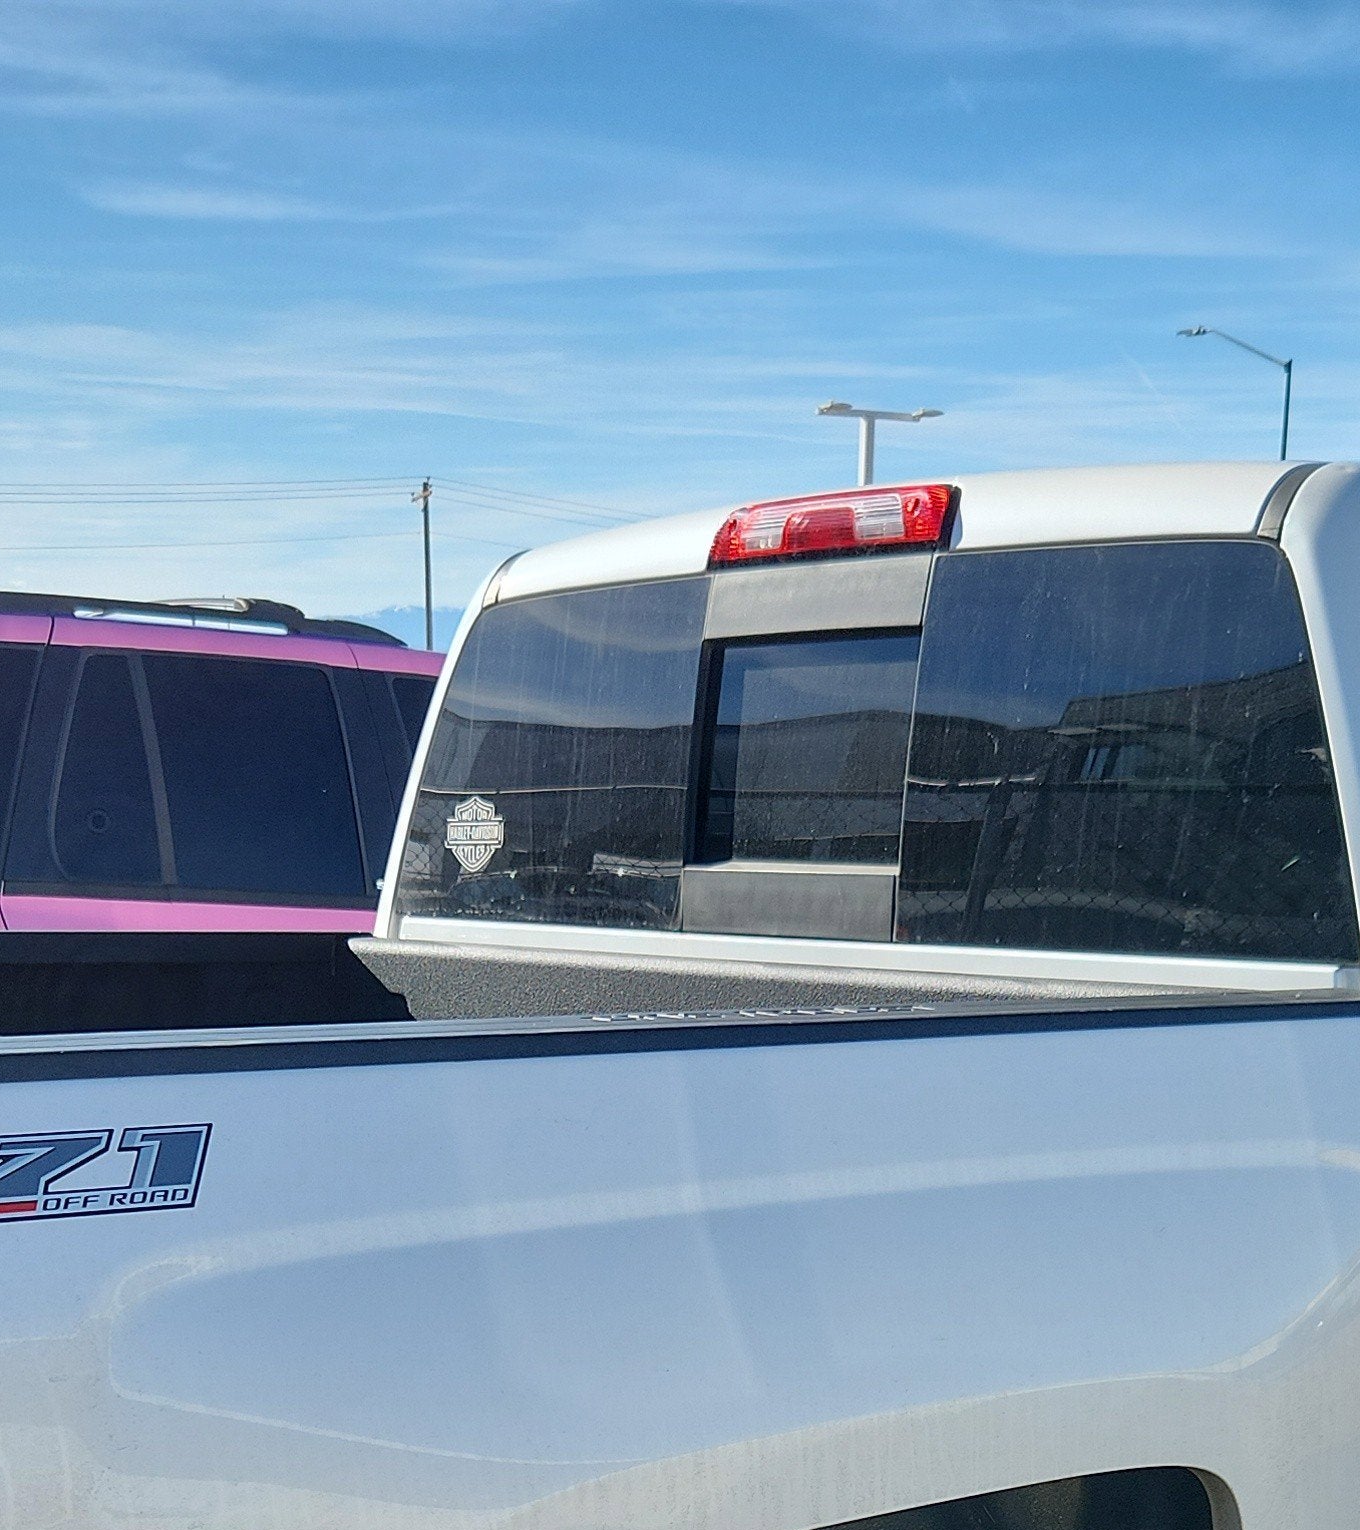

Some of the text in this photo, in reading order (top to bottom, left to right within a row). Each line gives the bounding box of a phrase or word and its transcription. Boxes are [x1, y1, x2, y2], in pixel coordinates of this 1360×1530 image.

[461, 806, 488, 821] MOTOR
[42, 1187, 191, 1212] OFF ROAD
